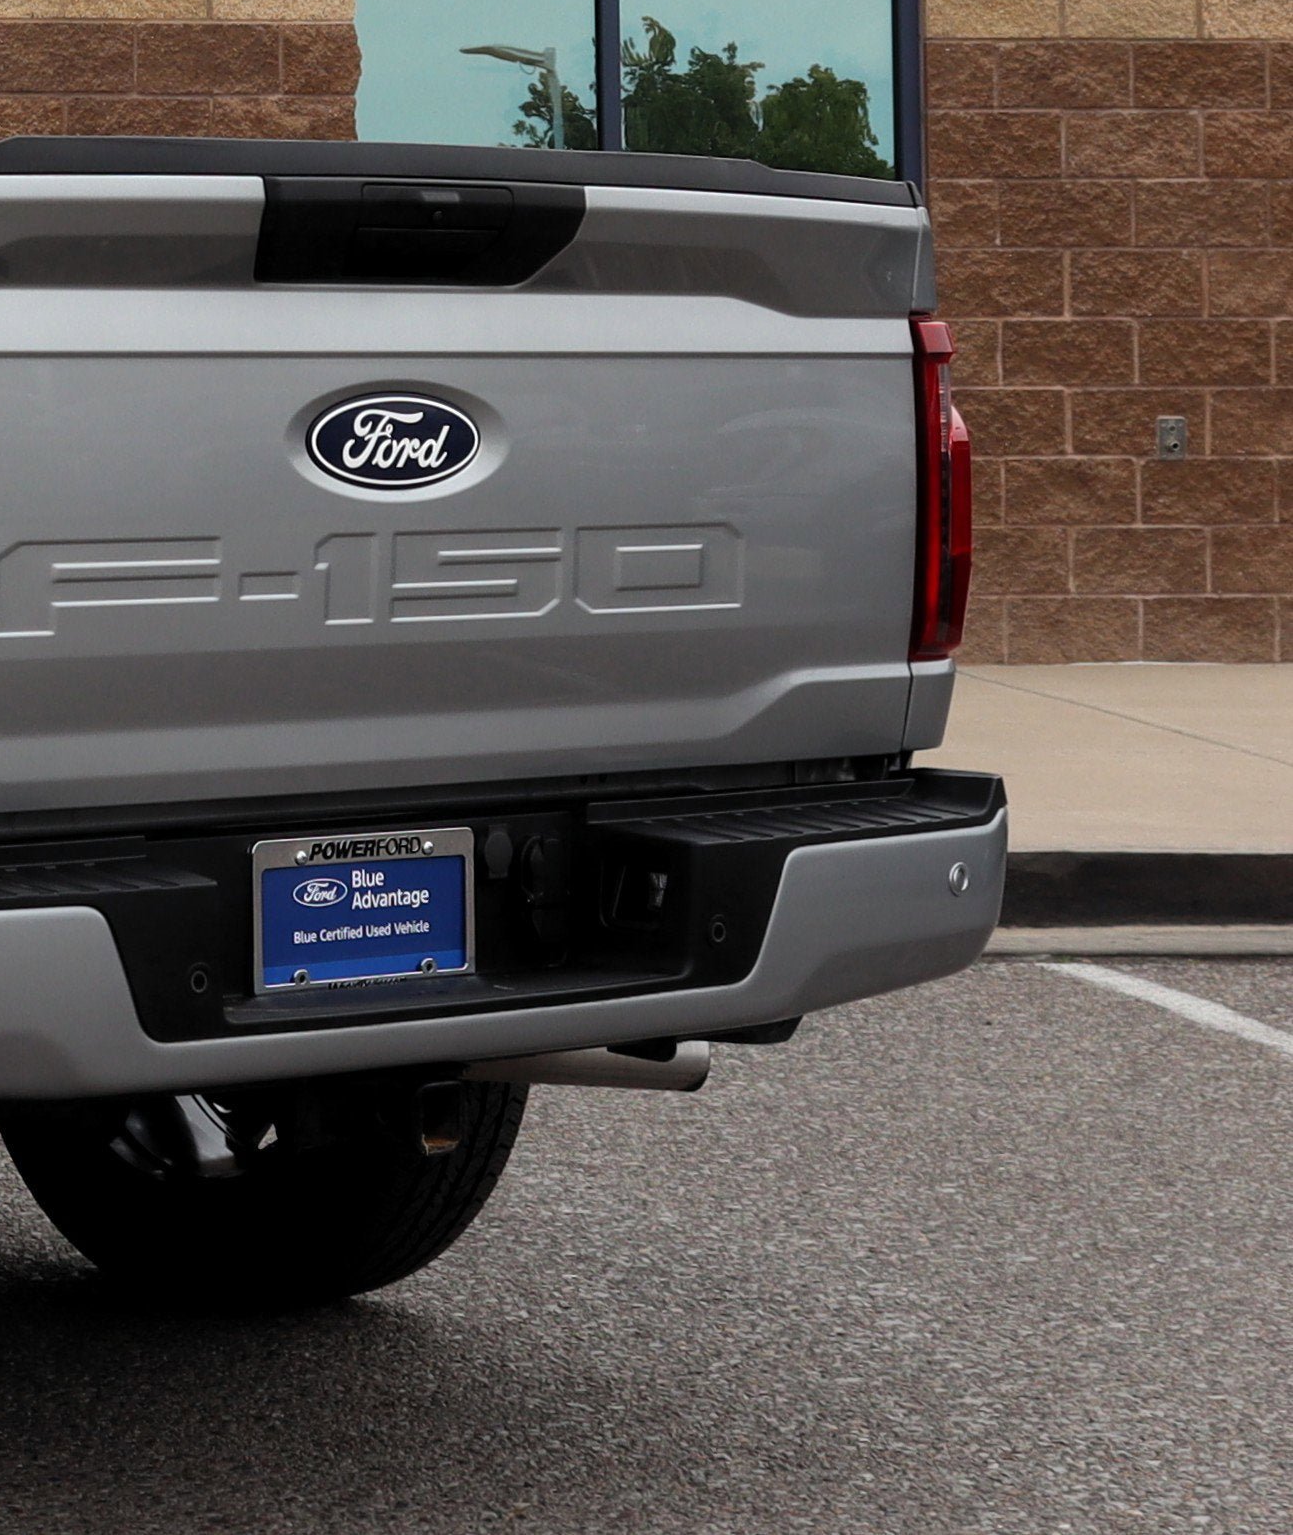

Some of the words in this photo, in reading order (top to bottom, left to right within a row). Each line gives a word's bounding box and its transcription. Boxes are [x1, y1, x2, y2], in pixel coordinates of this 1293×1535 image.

[342, 407, 451, 470] Ford
[309, 836, 422, 861] POWERFORD
[351, 869, 385, 888] Blue
[303, 882, 338, 902] Ford
[351, 888, 430, 910] Advantage
[293, 930, 317, 945] Blue
[319, 925, 363, 942] Certified
[365, 922, 391, 939] Used
[393, 920, 430, 936] Vehicle
